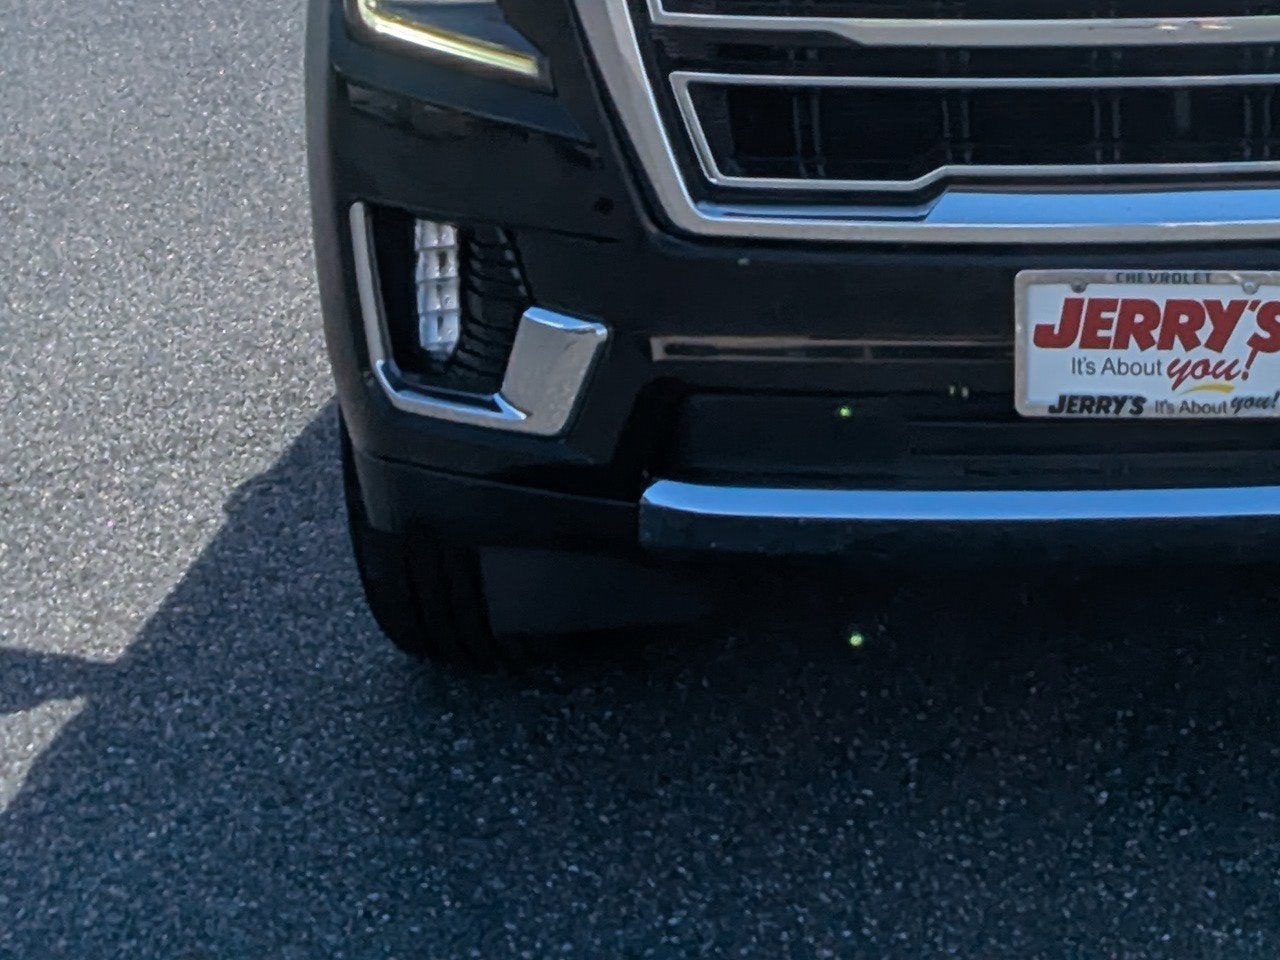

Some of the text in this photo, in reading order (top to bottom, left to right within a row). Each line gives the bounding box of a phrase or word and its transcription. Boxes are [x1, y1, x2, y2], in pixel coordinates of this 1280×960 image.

[1115, 272, 1213, 285] CHEVROLET
[1071, 347, 1259, 391] It's About you!
[1048, 390, 1280, 415] JERRY'S It's About you!
